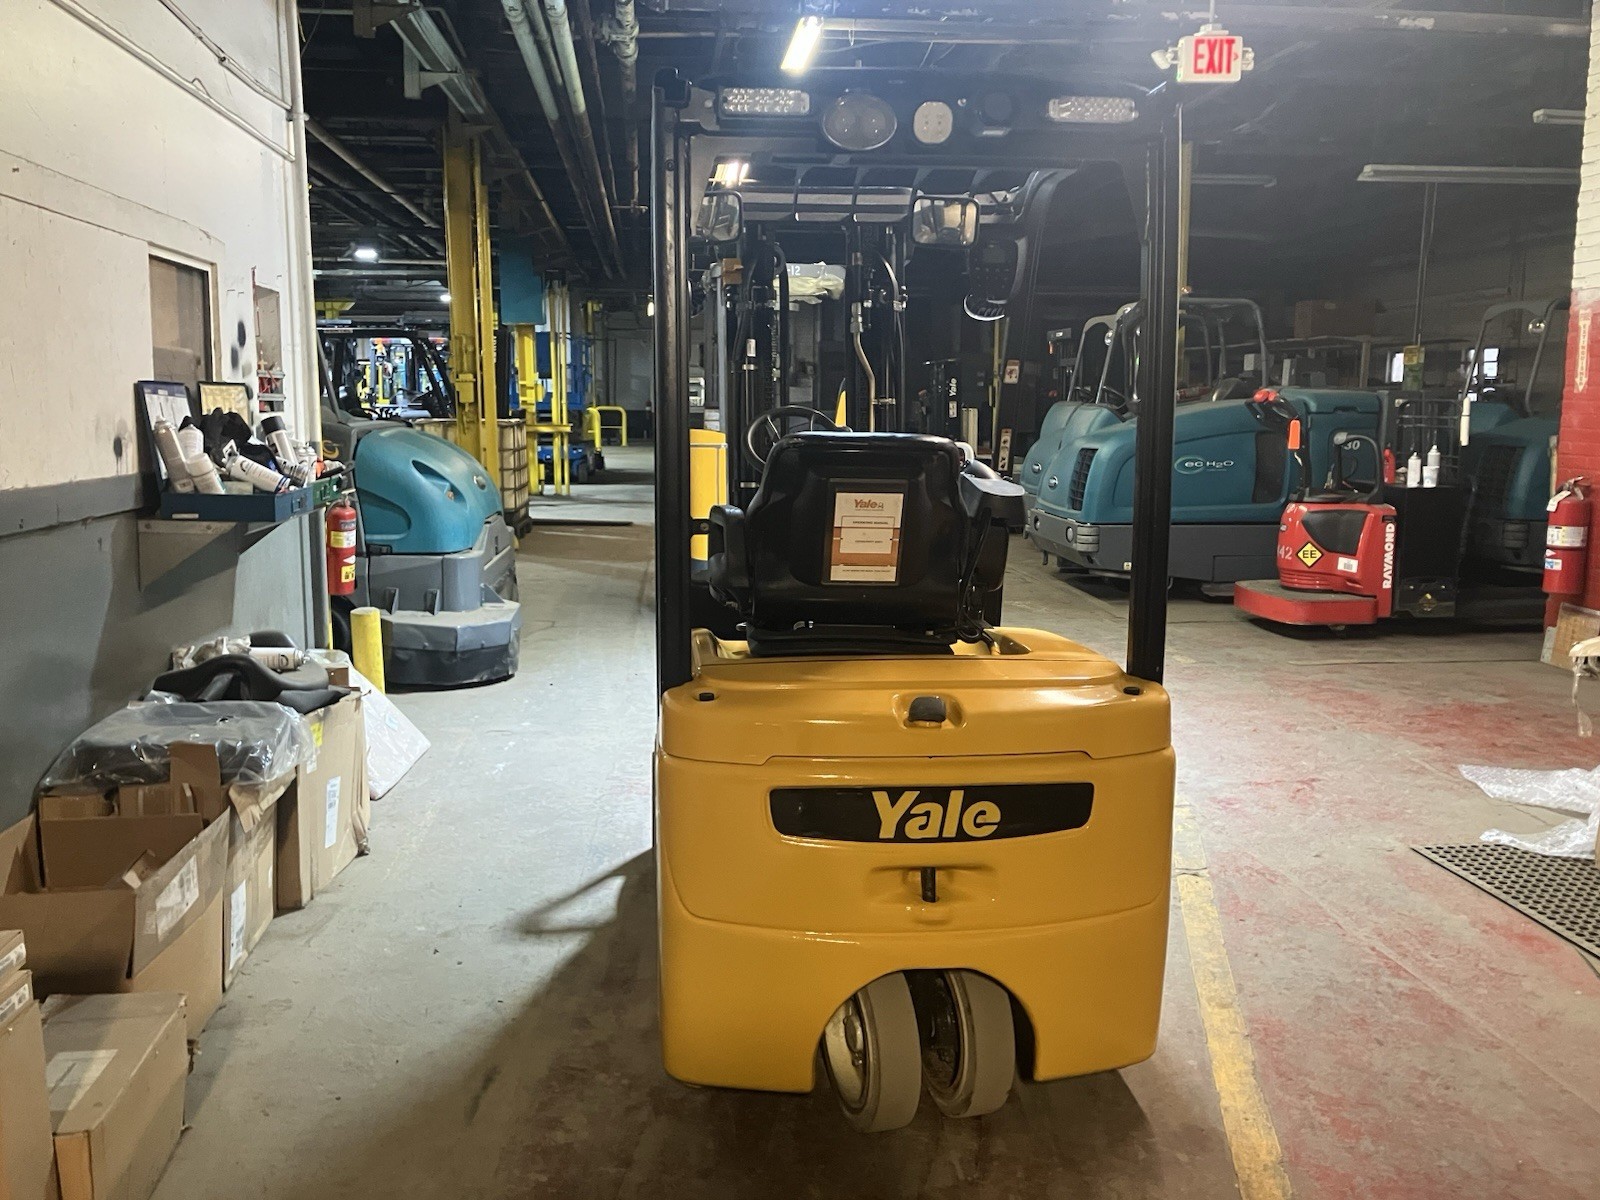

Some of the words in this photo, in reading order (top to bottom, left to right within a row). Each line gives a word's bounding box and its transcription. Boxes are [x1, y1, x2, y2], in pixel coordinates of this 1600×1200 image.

[1194, 39, 1235, 74] EXIT
[949, 378, 957, 397] Yale
[854, 499, 877, 508] Yale
[1302, 549, 1317, 559] EE
[1382, 523, 1396, 589] RAYMOND
[871, 789, 1002, 839] Yale
